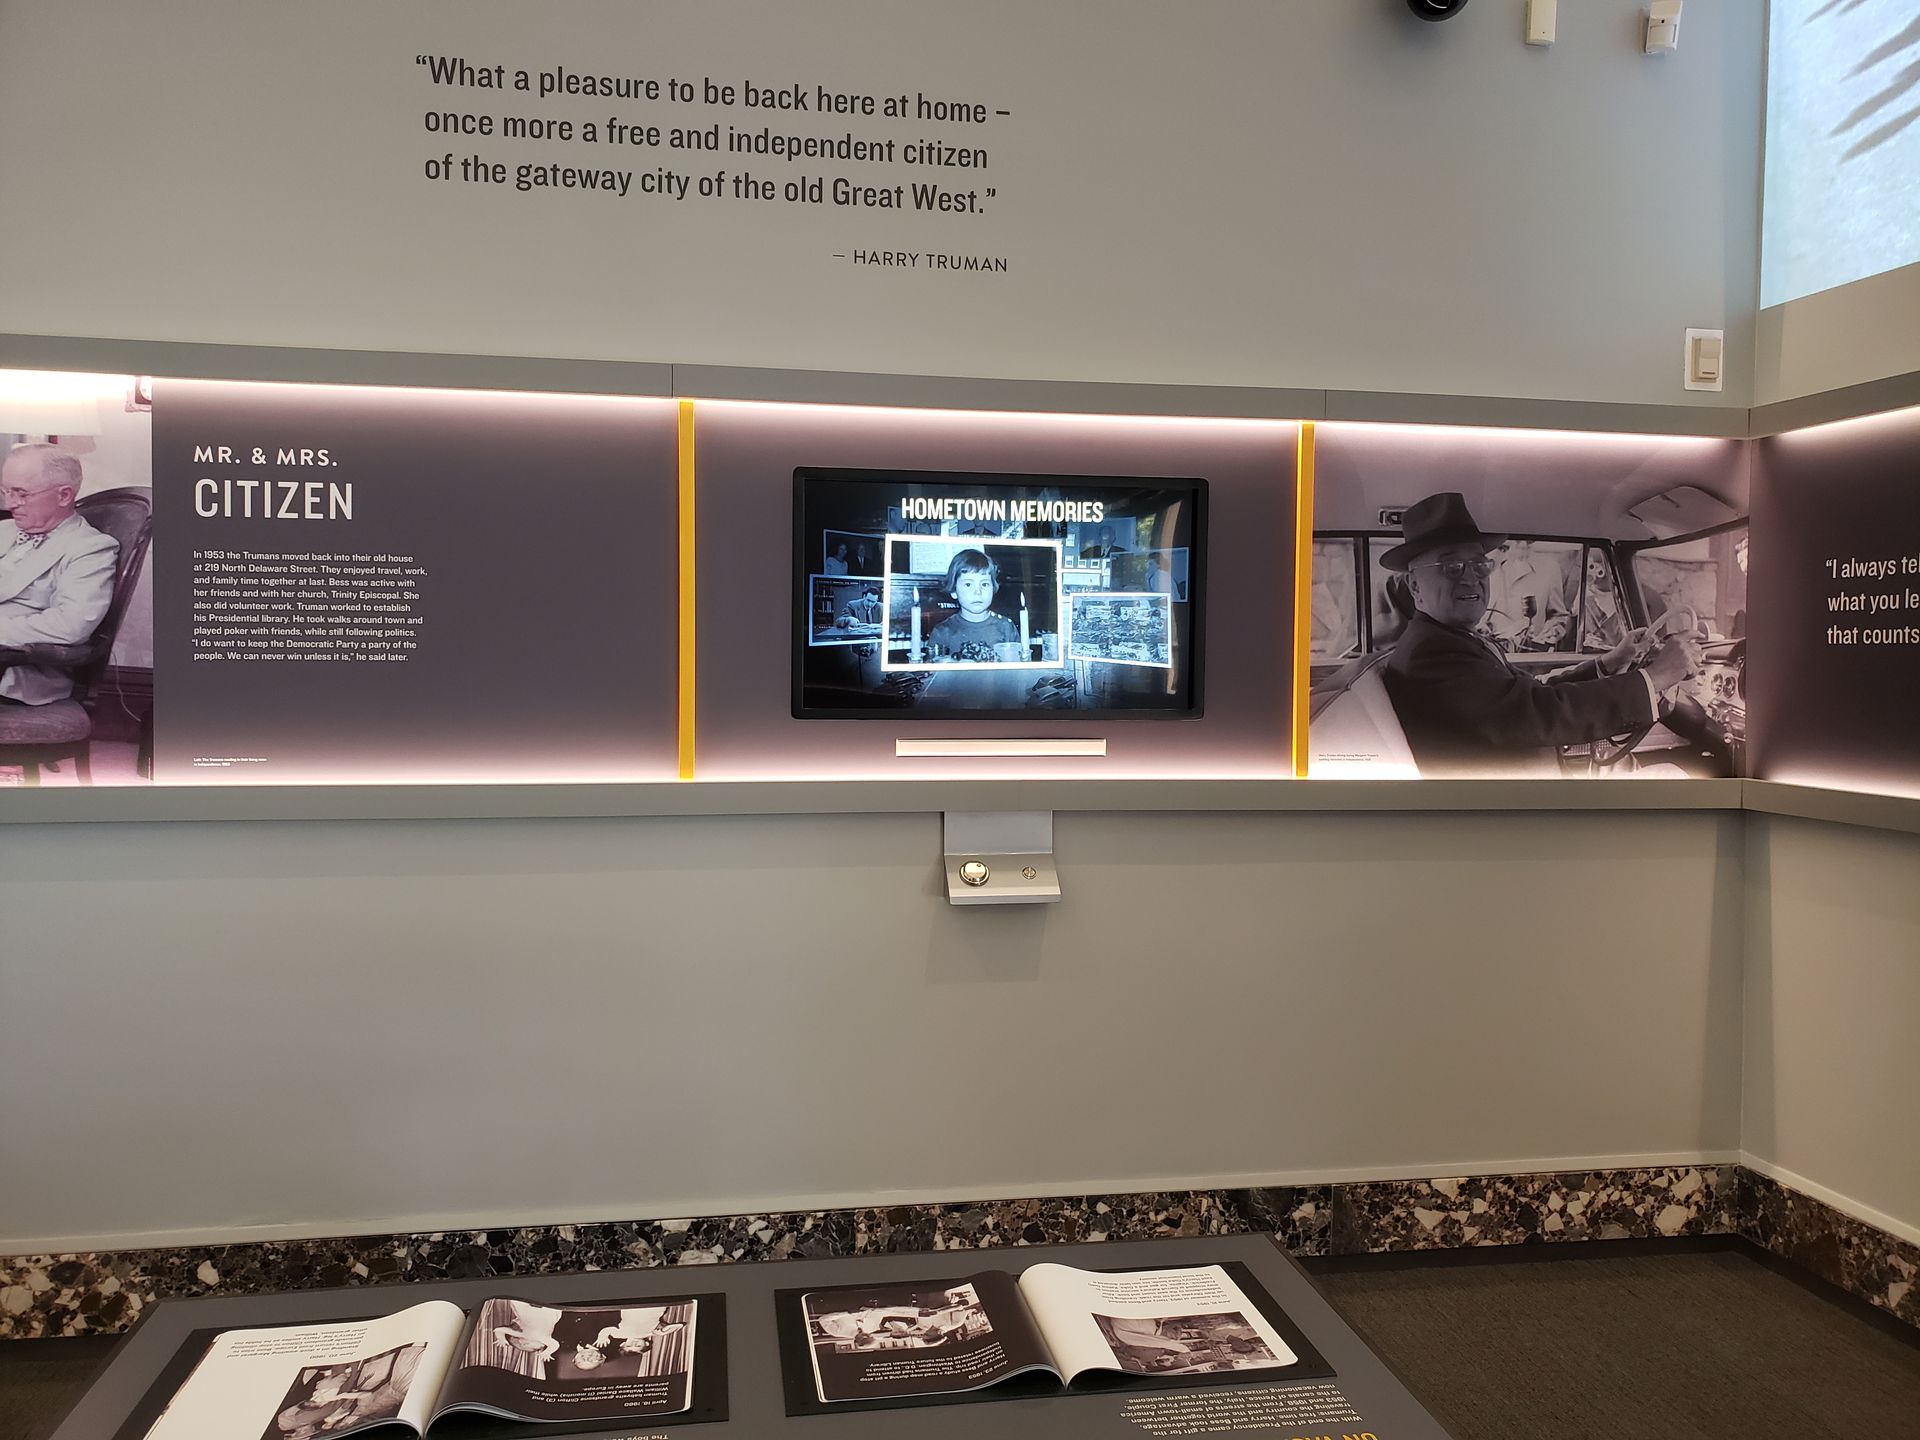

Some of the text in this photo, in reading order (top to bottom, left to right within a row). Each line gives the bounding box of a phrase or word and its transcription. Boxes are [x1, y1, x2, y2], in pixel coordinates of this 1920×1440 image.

[416, 55, 505, 89] “What
[514, 71, 530, 91] a
[540, 66, 660, 100] pleasure
[668, 78, 694, 103] to
[704, 77, 735, 106] be
[745, 80, 809, 111] back
[818, 85, 875, 116] here
[884, 95, 909, 118] at
[918, 93, 986, 124] home
[425, 112, 987, 169] once more a free and independent citizen
[425, 153, 996, 214] of the gateway city of the old Great West.”
[854, 249, 919, 267] HARRY
[926, 254, 1007, 273] TRUMAN
[194, 446, 337, 467] MR. & MRS.
[195, 478, 352, 520] CITIZEN
[902, 498, 1104, 524] HOMETOWN MEMORIES
[194, 550, 413, 563] In 1953 the Trumans moved back into their old house
[204, 563, 220, 572] 219
[222, 563, 246, 572] North
[248, 564, 288, 573] Delaware
[290, 564, 318, 573] Street.
[320, 565, 342, 575] They
[343, 566, 376, 576] enjoyed
[377, 566, 403, 575] travel,
[405, 567, 428, 576] work,
[1841, 557, 1896, 580] always
[193, 576, 210, 584] and
[212, 576, 238, 586] family
[240, 577, 259, 585] time
[261, 577, 297, 587] together
[309, 577, 327, 586] last.
[329, 578, 350, 586] Bess
[370, 579, 395, 587] active
[397, 579, 415, 587] with
[194, 588, 420, 601] her friends and with her church, Trinity Episcopal. She
[1828, 592, 1866, 612] what
[1870, 594, 1899, 615] you
[193, 601, 212, 609] also
[214, 601, 227, 610] did
[229, 601, 269, 610] volunteer
[271, 602, 295, 610] work.
[296, 602, 328, 611] Truman
[330, 603, 361, 611] worked
[373, 603, 411, 612] establish
[194, 613, 207, 622] his
[209, 613, 260, 622] Presidential
[261, 614, 290, 624] library.
[293, 615, 305, 623] He
[306, 615, 325, 623] took
[327, 615, 351, 624] walks
[353, 616, 383, 624] around
[407, 616, 423, 624] and
[194, 626, 417, 638] played poker with friends, while still following politics.
[1827, 625, 1859, 644] that
[200, 639, 212, 647] do
[248, 639, 269, 649] keep
[270, 639, 285, 648] the
[286, 639, 334, 648] Democratic
[336, 640, 359, 650] Party
[368, 641, 391, 650] party
[393, 640, 402, 649] of
[403, 641, 417, 649] the
[194, 651, 225, 661] people.
[227, 652, 241, 660] We
[287, 652, 302, 660] win
[304, 652, 332, 660] unless
[356, 653, 367, 661] he
[368, 653, 386, 661] said
[388, 653, 408, 661] later.
